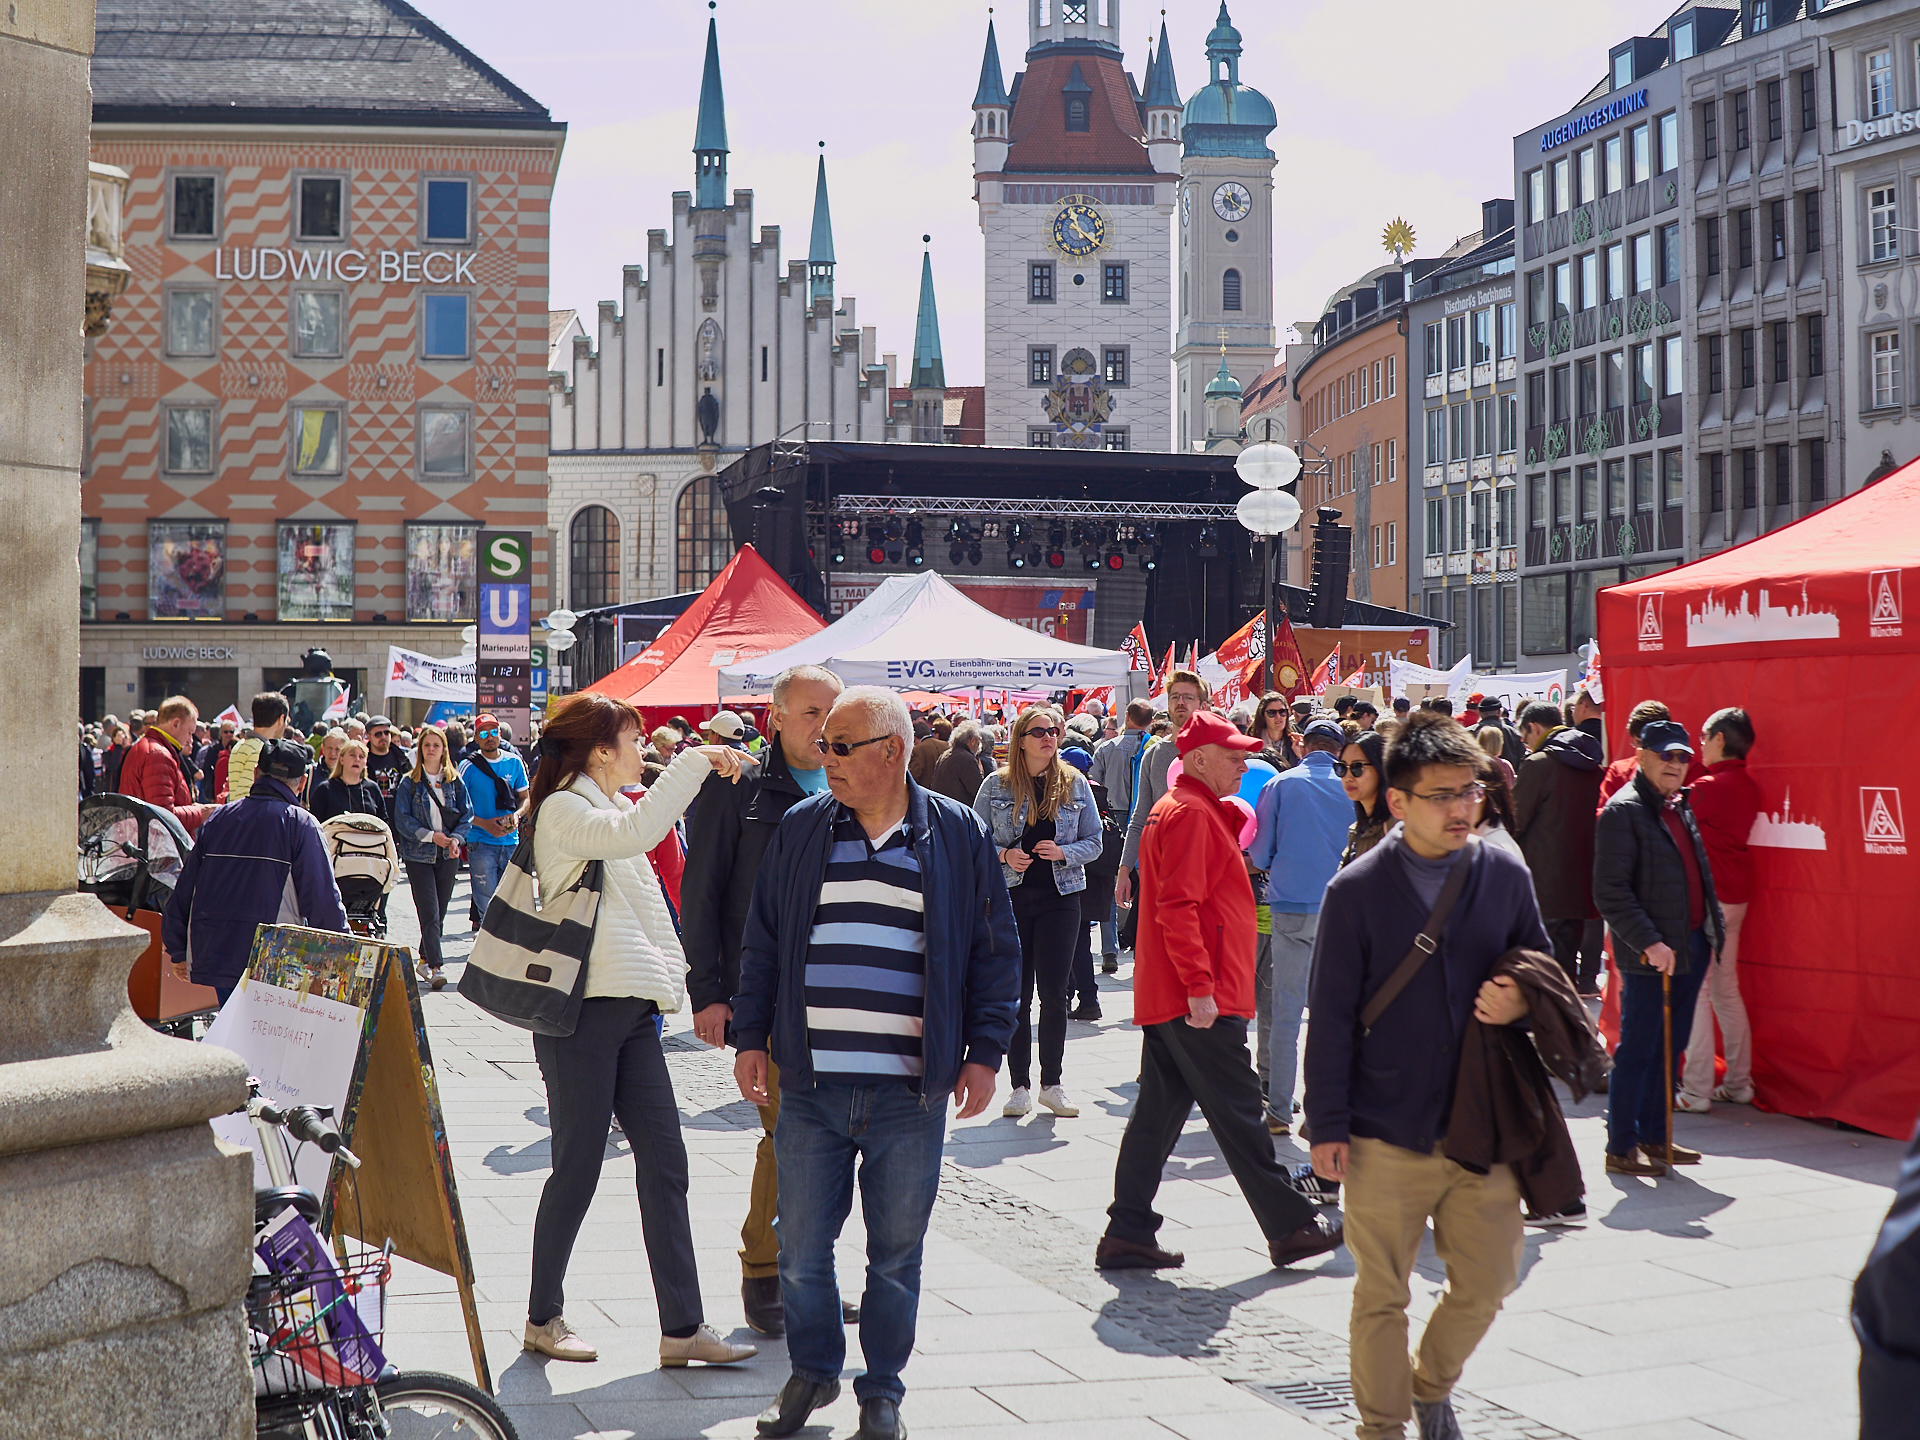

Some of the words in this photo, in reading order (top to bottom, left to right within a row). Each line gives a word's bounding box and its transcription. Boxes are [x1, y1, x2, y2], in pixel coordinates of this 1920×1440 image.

[1540, 88, 1648, 153] AUGENTAGESKLINIK
[215, 248, 368, 282] LUDWIG
[380, 249, 478, 284] BECK
[490, 537, 521, 577] S
[845, 588, 866, 598] MAI
[490, 589, 519, 628] U
[1012, 616, 1055, 637] TIG
[1869, 626, 1903, 638] München
[142, 646, 197, 660] LUDWIG
[199, 647, 234, 660] BECK
[481, 643, 528, 653] Marienplatz
[1638, 641, 1664, 652] München
[950, 660, 995, 668] Eisenbahn-
[1371, 649, 1408, 668] TAG
[431, 669, 458, 683] Rente
[492, 666, 520, 677] 11:21
[887, 660, 935, 678] EVG
[937, 669, 1025, 679] Verkehrsgewerkschaft
[1028, 661, 1074, 678] EVG
[497, 696, 508, 704] U6
[1864, 842, 1908, 855] München
[251, 1020, 314, 1049] FREUNDSCHAFT!
